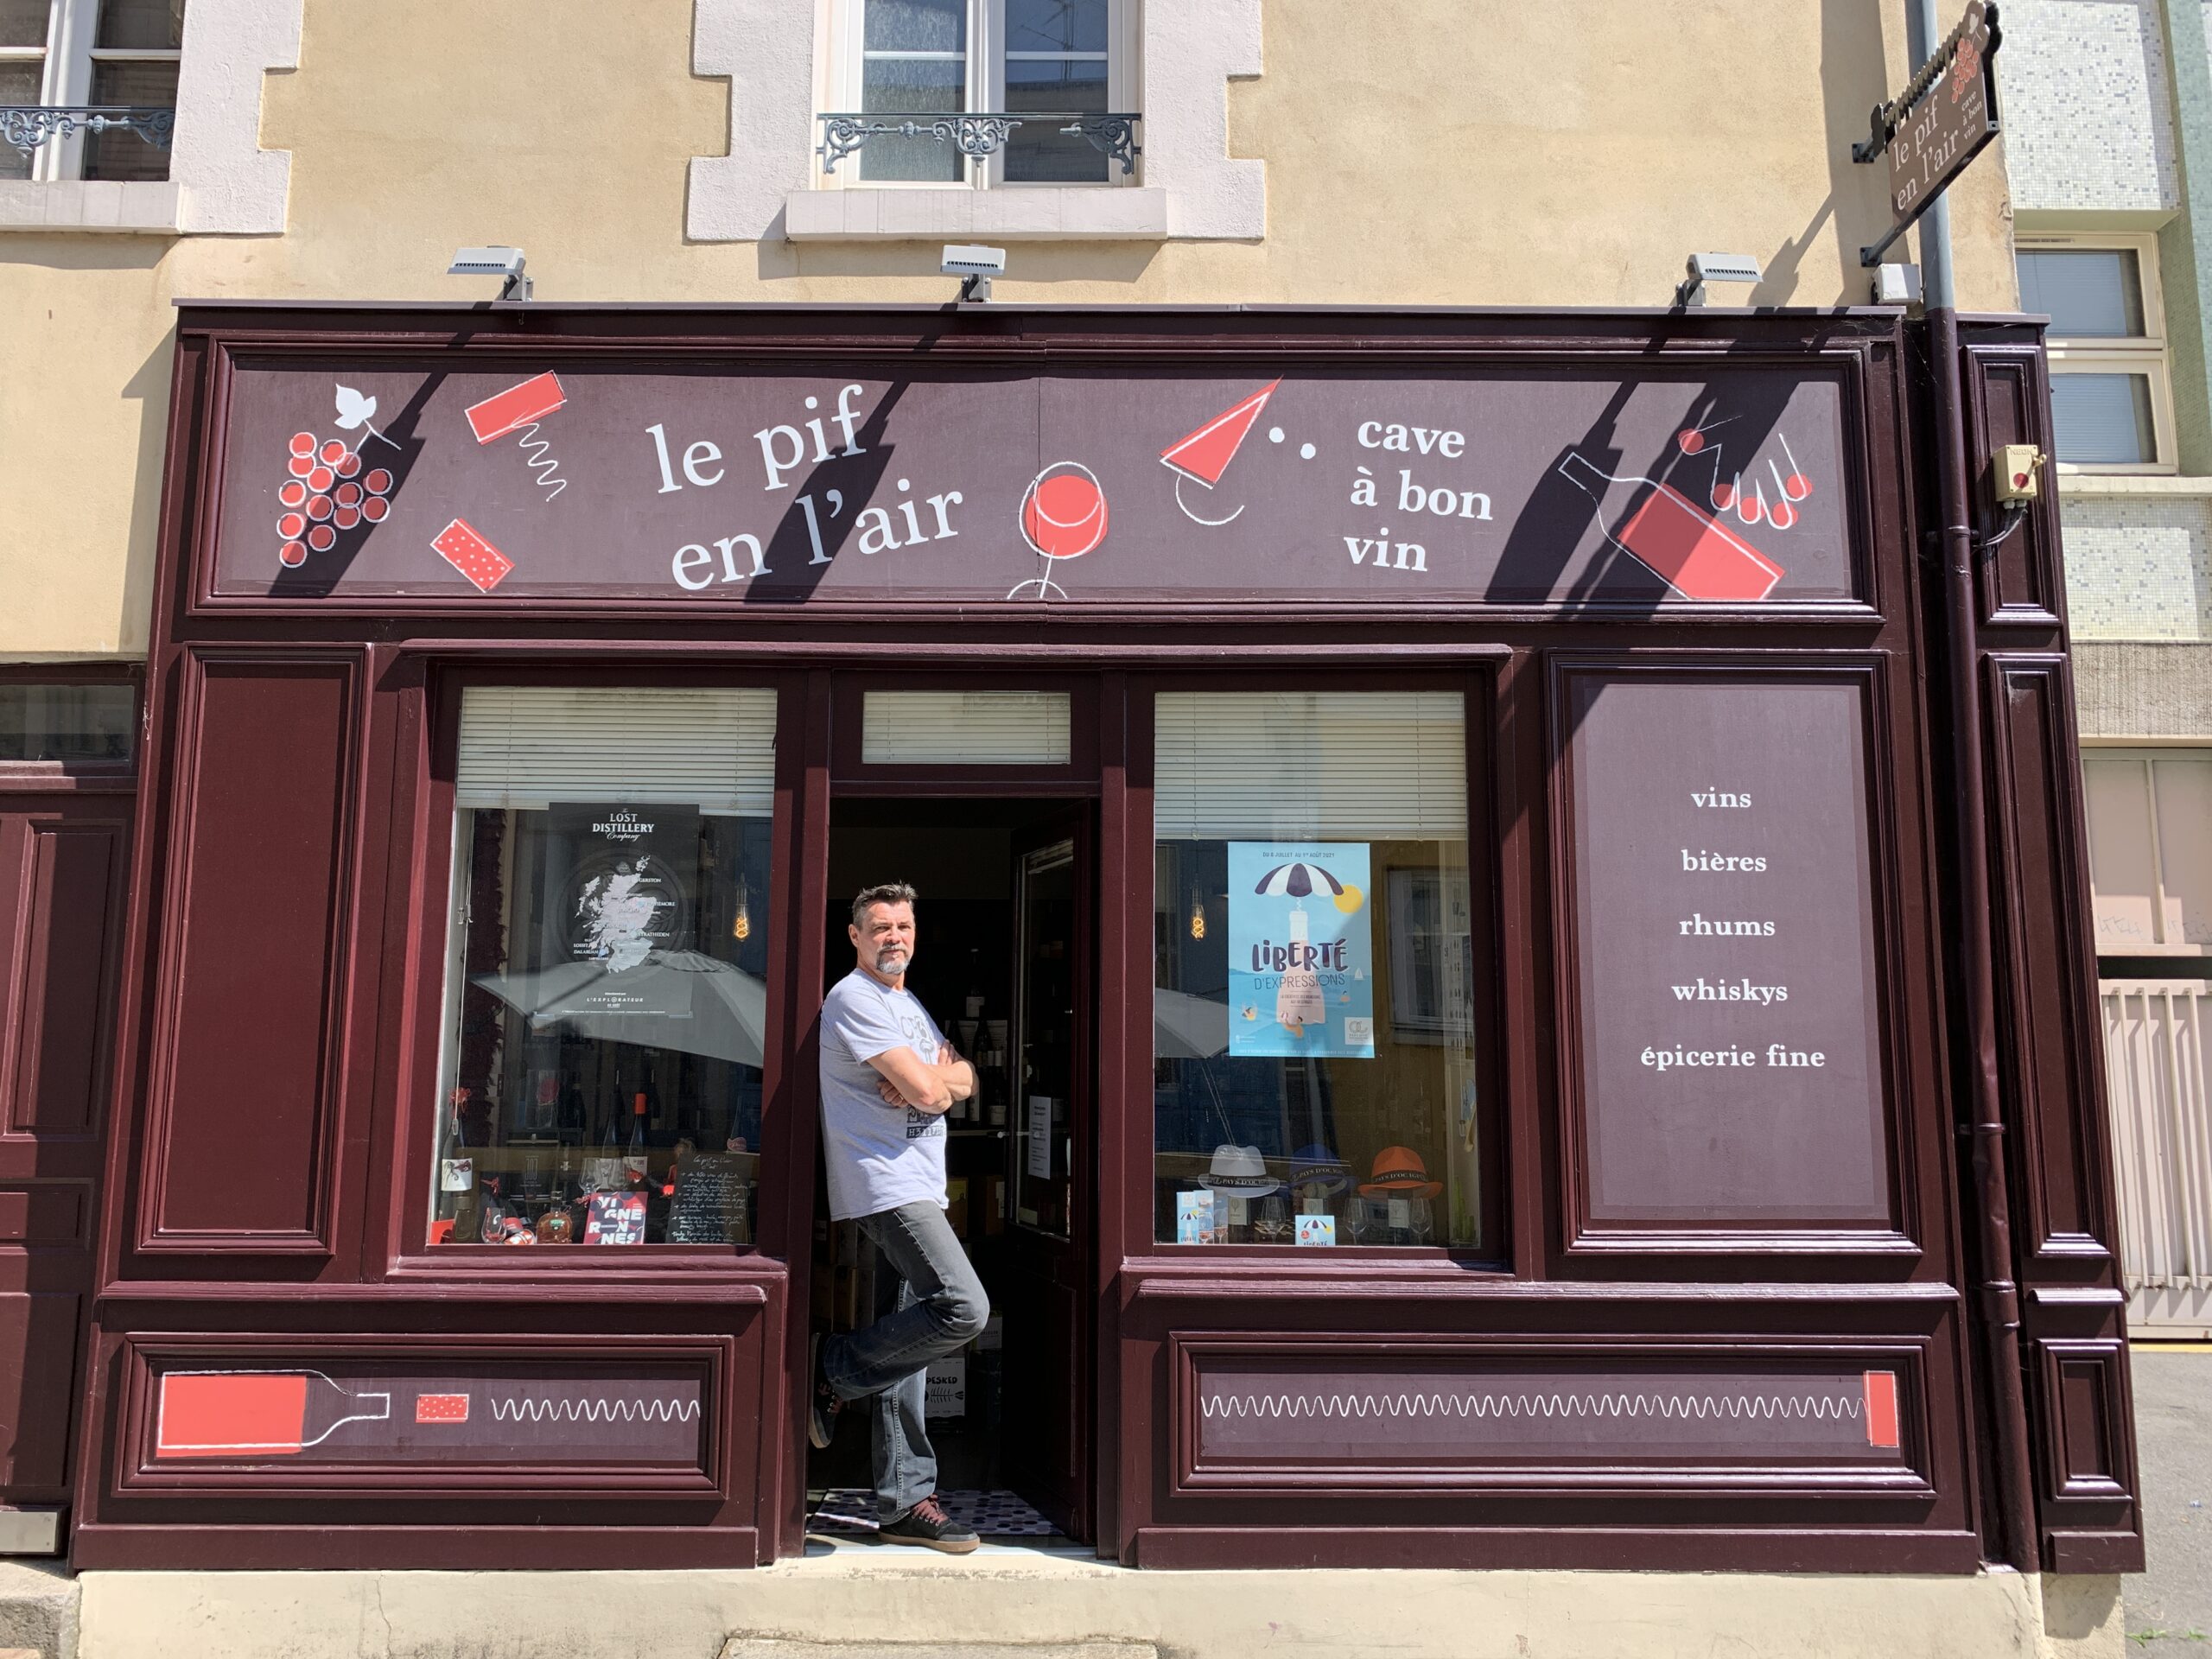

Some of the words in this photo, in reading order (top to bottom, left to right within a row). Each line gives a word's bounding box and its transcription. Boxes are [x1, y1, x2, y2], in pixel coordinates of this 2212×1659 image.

[1961, 90, 1977, 111] cave
[1962, 113, 1969, 128] à
[1968, 101, 1982, 120] bon
[1892, 139, 1910, 173] le
[1915, 94, 1940, 157] pif
[1963, 124, 1976, 141] vin
[1897, 177, 1918, 210] en
[1923, 128, 1959, 184] l'air
[645, 423, 725, 494] le
[753, 383, 868, 492] pif
[1357, 420, 1465, 459] cave
[1350, 466, 1378, 506] à
[1398, 469, 1493, 521] bon
[671, 530, 772, 591] en
[795, 478, 963, 567] l'air
[1344, 527, 1428, 572] vin
[1691, 786, 1752, 809] vins
[592, 823, 655, 833] DISTILLERY
[609, 813, 638, 823] LOST
[606, 831, 641, 842] Company
[1681, 849, 1767, 872] bières
[1679, 913, 1776, 936] rhums
[1254, 973, 1345, 990] D'EXPRESSIONS
[1671, 979, 1789, 1006] whiskys
[1641, 1045, 1756, 1071] épicerie
[1767, 1045, 1826, 1067] fine
[926, 1376, 958, 1384] PESKED
